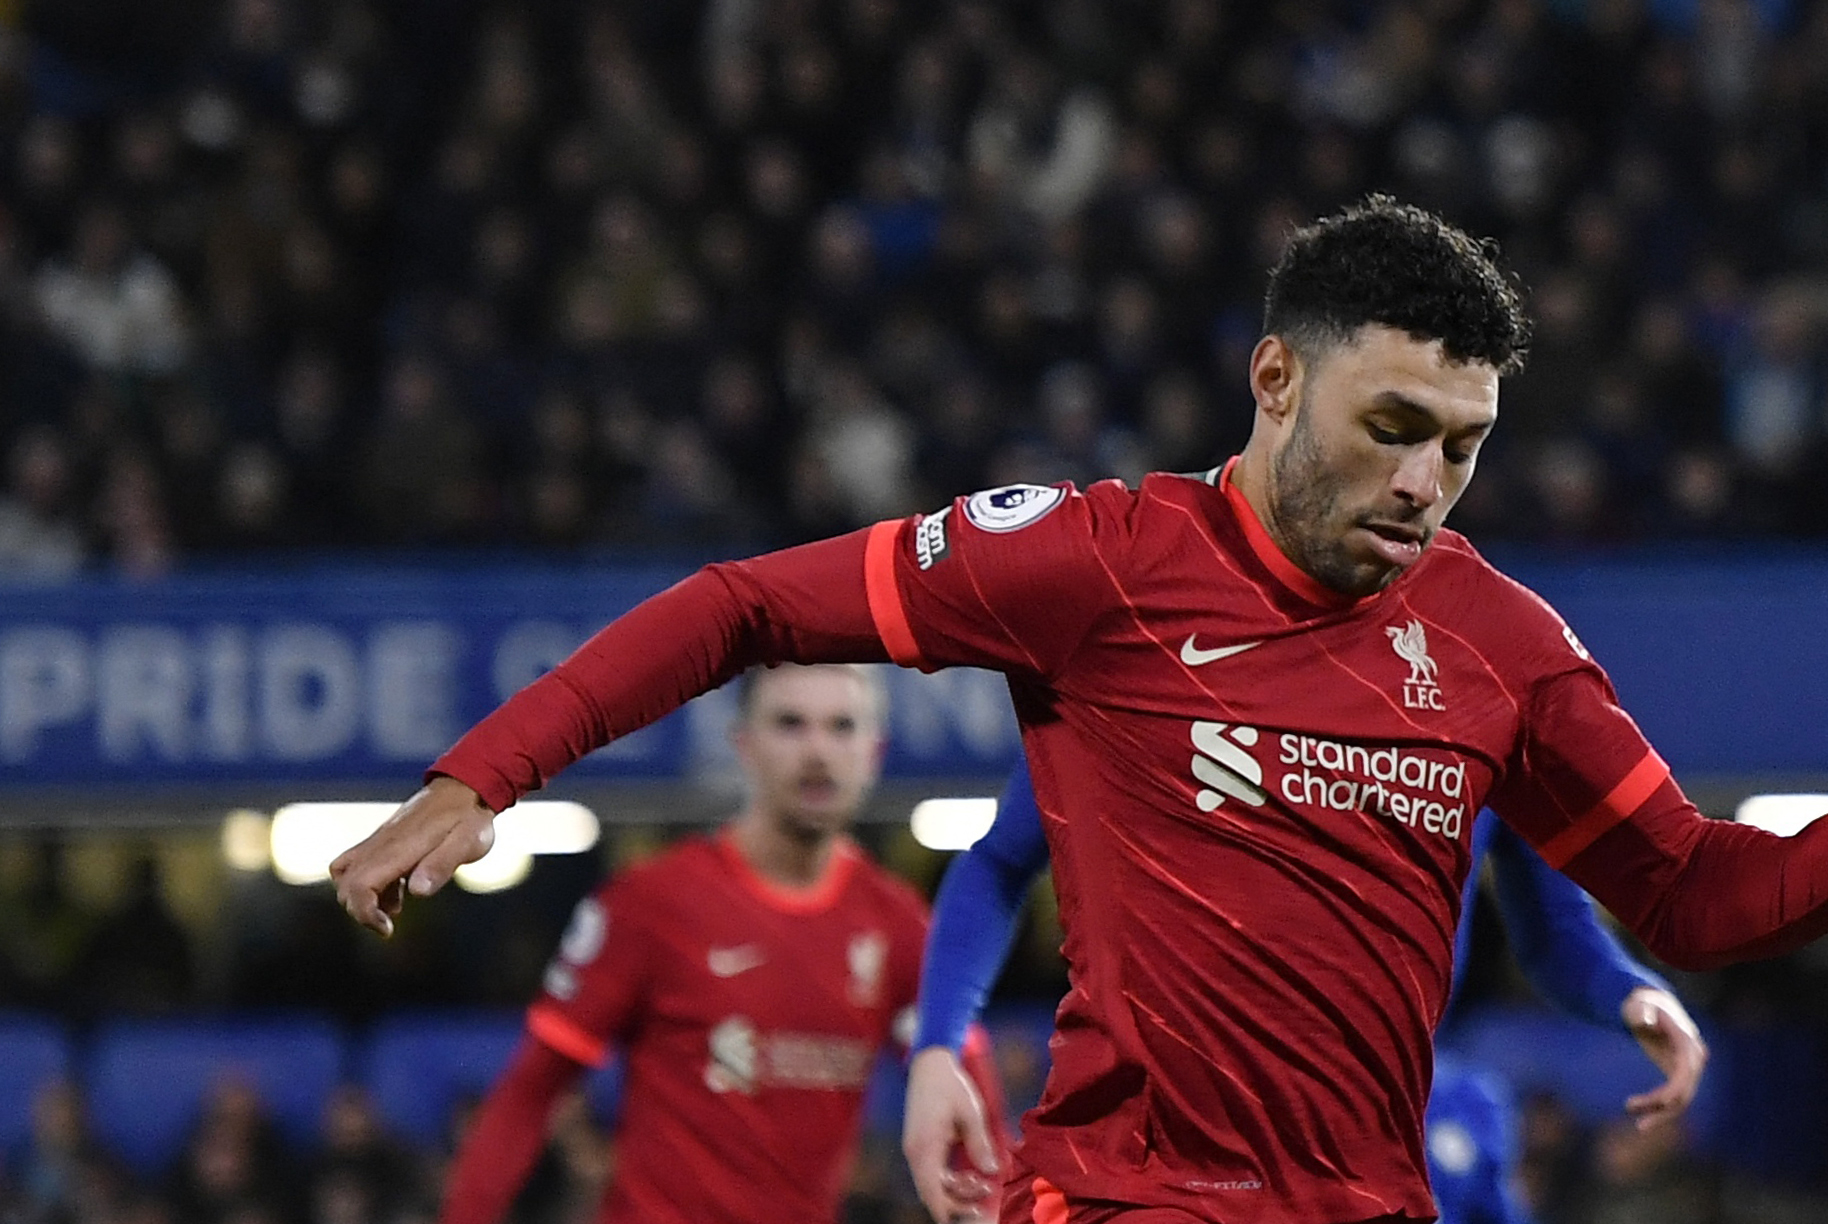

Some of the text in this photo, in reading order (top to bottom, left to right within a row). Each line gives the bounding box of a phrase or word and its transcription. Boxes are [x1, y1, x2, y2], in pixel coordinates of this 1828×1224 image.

[0, 622, 464, 764] PRIDE
[1279, 733, 1466, 799] standard
[1281, 767, 1465, 840] chartered
